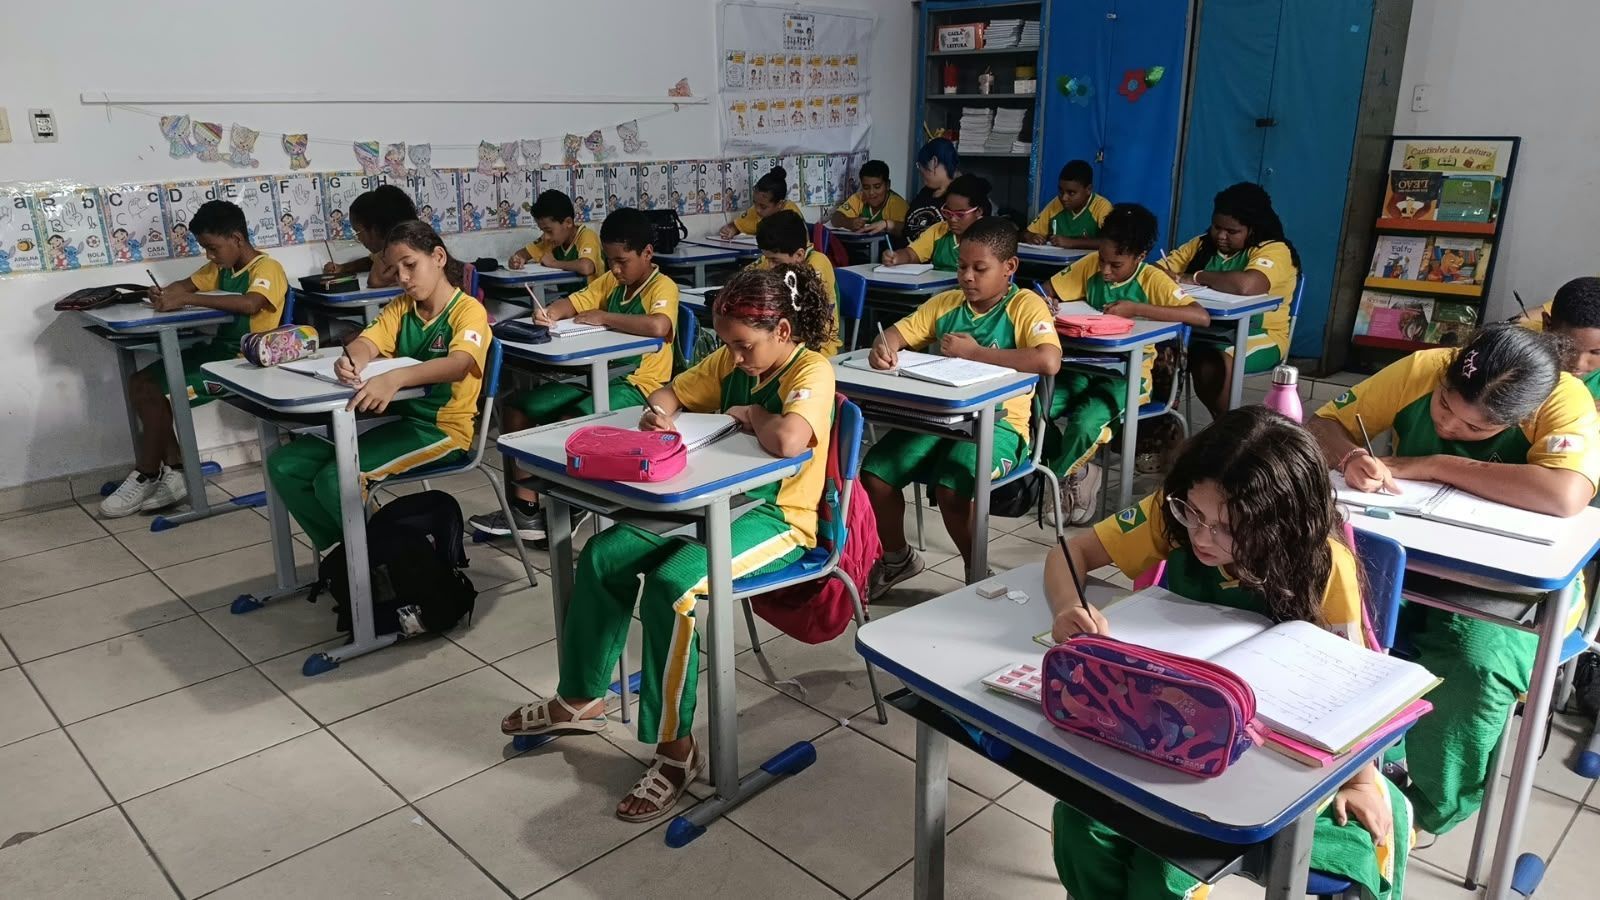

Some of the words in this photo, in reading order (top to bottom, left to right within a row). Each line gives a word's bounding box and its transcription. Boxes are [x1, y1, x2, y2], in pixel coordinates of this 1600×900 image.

[1410, 146, 1448, 155] Cantinho
[1450, 146, 1460, 154] da
[1462, 146, 1492, 157] Leitura
[725, 163, 731, 173] R
[743, 162, 747, 170] r
[753, 161, 758, 170] S
[770, 159, 775, 167] s
[803, 159, 808, 168] U
[828, 158, 833, 167] V
[576, 169, 584, 179] M
[596, 169, 603, 178] m
[610, 169, 617, 178] N
[630, 167, 637, 176] n
[641, 167, 648, 177] O
[661, 165, 667, 174] o
[691, 164, 696, 173] p
[700, 164, 706, 174] Q
[377, 175, 387, 185] H
[407, 176, 414, 187] h
[451, 174, 454, 186] i
[464, 173, 470, 183] J
[501, 172, 509, 183] K
[526, 172, 532, 182] k
[540, 172, 547, 182] L
[280, 181, 289, 194] F
[312, 178, 317, 190] f
[330, 177, 340, 188] G
[361, 177, 369, 189] g
[169, 188, 182, 202] D
[205, 187, 216, 200] d
[226, 185, 238, 197] E
[260, 182, 270, 193] e
[14, 197, 27, 209] a
[82, 196, 94, 209] b
[109, 192, 122, 206] C
[148, 192, 158, 203] c
[824, 208, 828, 216] X
